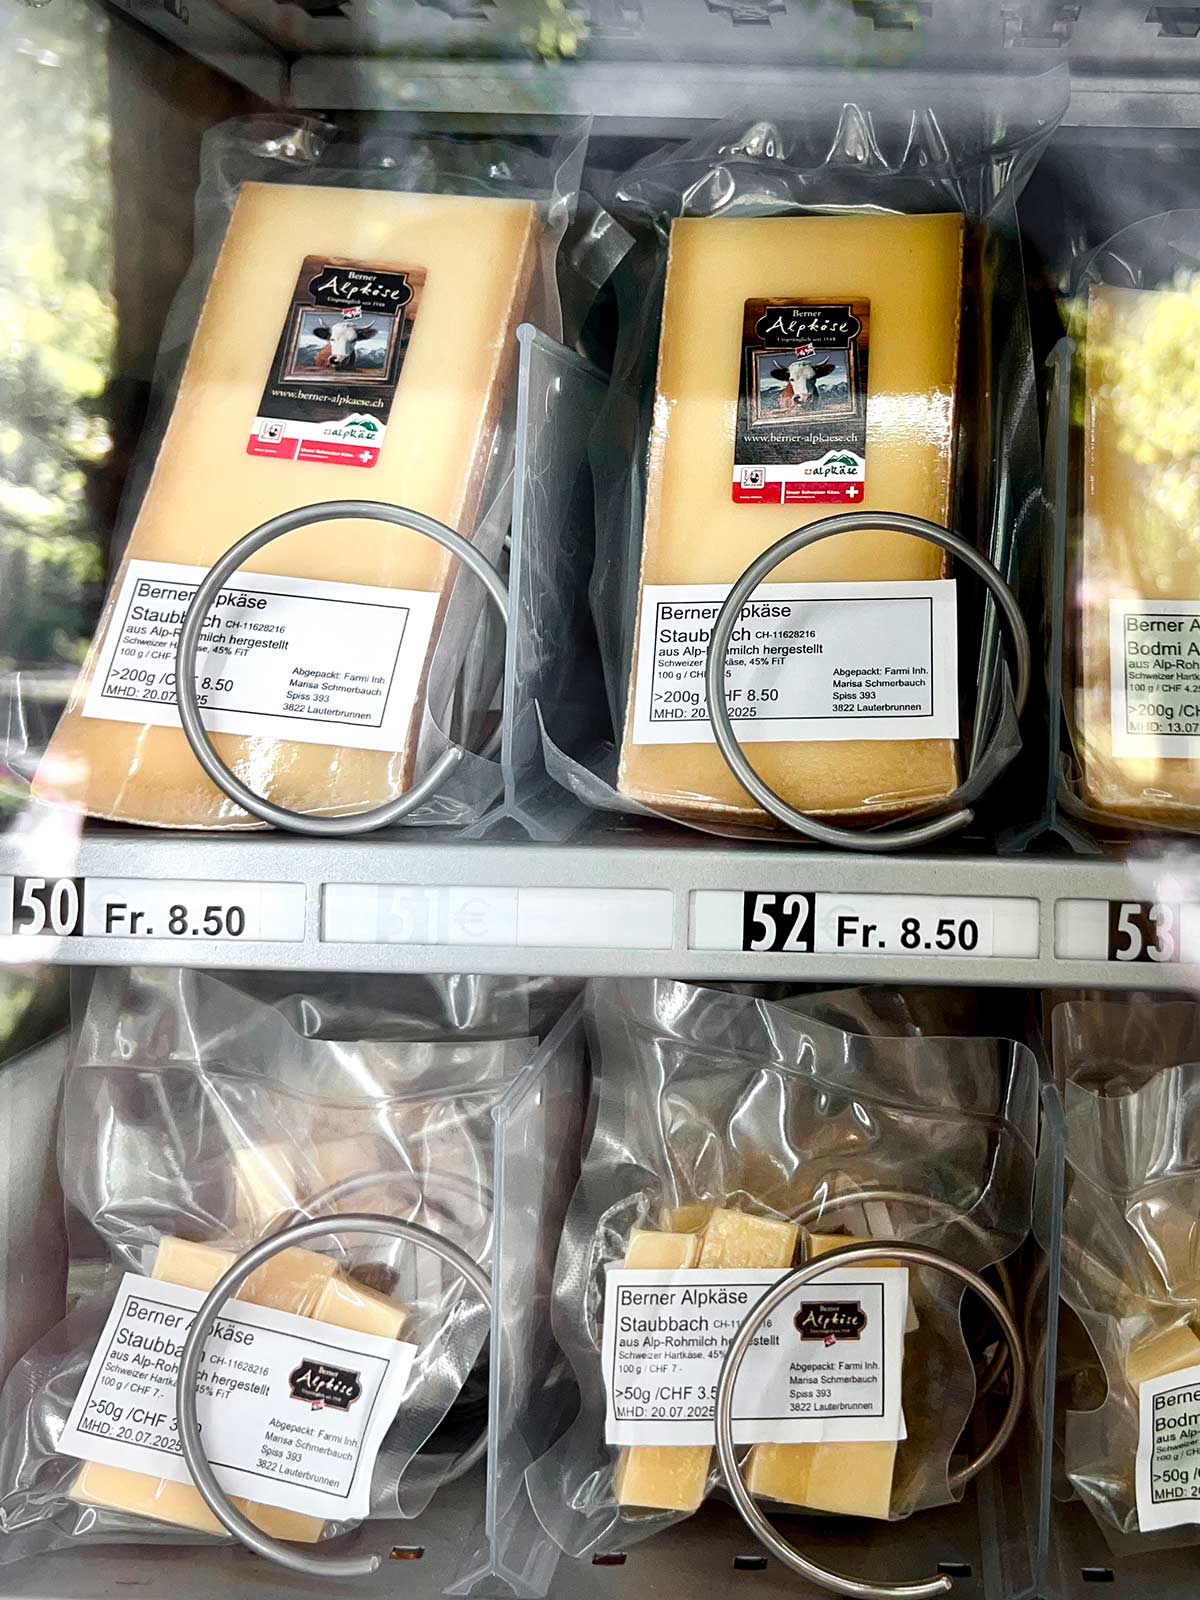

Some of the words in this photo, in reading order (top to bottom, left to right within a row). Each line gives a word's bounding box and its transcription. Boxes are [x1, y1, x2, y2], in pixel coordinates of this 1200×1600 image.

[348, 271, 377, 281] Berner
[271, 389, 385, 408] www.berner-alpkaese.ch
[743, 433, 858, 444] www.berner-alpkaese.ch
[813, 466, 858, 477] alpkäse
[214, 592, 266, 609] pkäse
[661, 606, 719, 620] Berner
[740, 604, 792, 621] pkäse
[225, 619, 286, 634] CH-11628216
[1127, 618, 1185, 632] Berner
[126, 625, 147, 635] aus
[150, 626, 217, 645] Alp-Rmilch
[229, 634, 289, 650] hergestellt
[659, 627, 751, 643] Staubch
[755, 630, 816, 640] CH-11628216
[122, 636, 167, 649] Schweizer
[212, 645, 232, 655] 45%
[763, 644, 823, 657] hergestellt
[1128, 641, 1182, 656] Bodmi
[120, 648, 136, 657] 100
[137, 651, 144, 659] g
[151, 651, 172, 660] CHF
[658, 659, 703, 667] Schweizer
[749, 657, 769, 666] 45%
[772, 656, 786, 665] FiT
[833, 668, 882, 678] Abgepackt:
[885, 667, 910, 675] Farmi
[912, 667, 929, 675] Inh.
[1129, 661, 1150, 669] aus
[110, 667, 156, 687] >200g
[201, 677, 234, 693] 8.50
[292, 667, 342, 681] Abgepackt:
[658, 671, 674, 679] 100
[675, 672, 682, 681] g
[1129, 671, 1175, 680] Schweizer
[289, 679, 319, 691] Marisa
[320, 682, 382, 697] Schmerbauch
[833, 680, 862, 688] Marisa
[865, 679, 926, 688] Schmerbauch
[1161, 684, 1182, 692] CHF
[106, 685, 140, 698] MHD:
[285, 691, 311, 702] Spiss
[313, 693, 331, 703] 393
[654, 691, 700, 706] >200g
[747, 688, 779, 702] 8.50
[833, 692, 857, 701] Spiss
[860, 691, 876, 699] 393
[282, 702, 306, 713] 3822
[307, 705, 372, 720] Lauterbrunnen
[654, 708, 687, 719] MHD:
[833, 703, 855, 711] 3822
[857, 703, 922, 712] Lauterbrunnen
[1128, 704, 1175, 720] >200g
[1168, 723, 1200, 733] 13.07
[19, 878, 79, 937] 50
[105, 903, 153, 935] Fr.
[168, 905, 246, 938] 8.50
[750, 893, 810, 952] 52
[837, 916, 886, 948] Fr.
[900, 917, 979, 951] 8.50
[1116, 903, 1175, 962] 53
[621, 1290, 676, 1305] Berner
[681, 1289, 748, 1308] Alpkäse
[126, 1301, 183, 1328] Berner
[620, 1316, 709, 1332] Staubbach
[713, 1319, 773, 1329] CH-1116
[619, 1339, 640, 1347] aus
[642, 1335, 718, 1349] Alp-Rohmilch
[619, 1351, 661, 1360] Schweizer
[105, 1362, 149, 1381] Schweizer
[209, 1354, 270, 1377] CH-11628216
[619, 1364, 634, 1373] 100
[636, 1367, 642, 1375] g
[649, 1364, 669, 1373] CHF
[790, 1362, 835, 1373] Abgepackt:
[838, 1361, 862, 1371] Farmi
[110, 1349, 130, 1362] aus
[211, 1370, 271, 1398] hergestellt
[790, 1376, 818, 1385] Marisa
[820, 1375, 878, 1384] Schmerbauch
[101, 1375, 116, 1387] 100
[116, 1380, 122, 1391] g
[130, 1384, 151, 1396] CHF
[615, 1387, 651, 1404] >50g
[654, 1386, 693, 1401] /CHF
[790, 1389, 813, 1399] Spiss
[816, 1389, 832, 1398] 393
[88, 1399, 123, 1421] >50g
[126, 1407, 168, 1428] /CHF
[617, 1406, 647, 1417] MHD:
[651, 1405, 716, 1418] 20.07.2025
[790, 1403, 811, 1411] 3822
[814, 1402, 873, 1411] Lauterbrunnen
[81, 1417, 114, 1434] MHD:
[116, 1425, 182, 1451] 20.07.2025
[269, 1418, 314, 1437] Abgepackt:
[265, 1431, 293, 1447] Marisa
[294, 1440, 353, 1461] Schmerbauch
[1156, 1434, 1176, 1444] aus
[1156, 1440, 1198, 1453] Schweizer
[261, 1444, 284, 1460] Spiss
[285, 1450, 303, 1463] 393
[256, 1458, 278, 1472] 3822
[279, 1464, 340, 1488] Lauterbrunnen
[1153, 1468, 1189, 1484] >50g
[1155, 1487, 1187, 1500] MHD:
